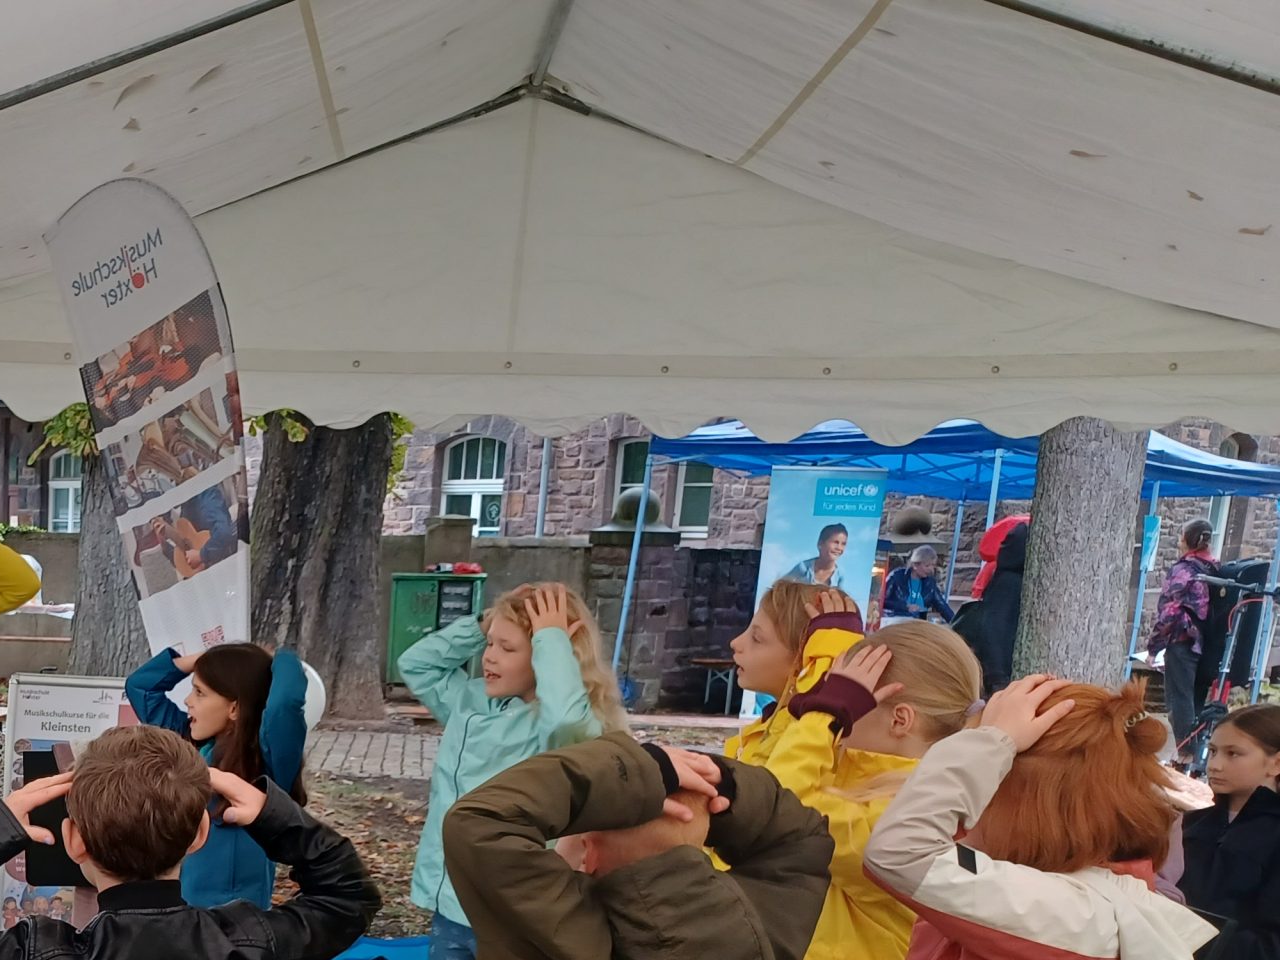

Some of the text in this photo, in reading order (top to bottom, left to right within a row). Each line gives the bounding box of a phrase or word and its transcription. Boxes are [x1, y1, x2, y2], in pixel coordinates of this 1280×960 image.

[824, 484, 863, 496] unicef
[823, 502, 833, 510] für
[859, 503, 876, 511] Kind
[24, 709, 84, 719] Musikschulkurse
[41, 721, 91, 733] Kleinsten
